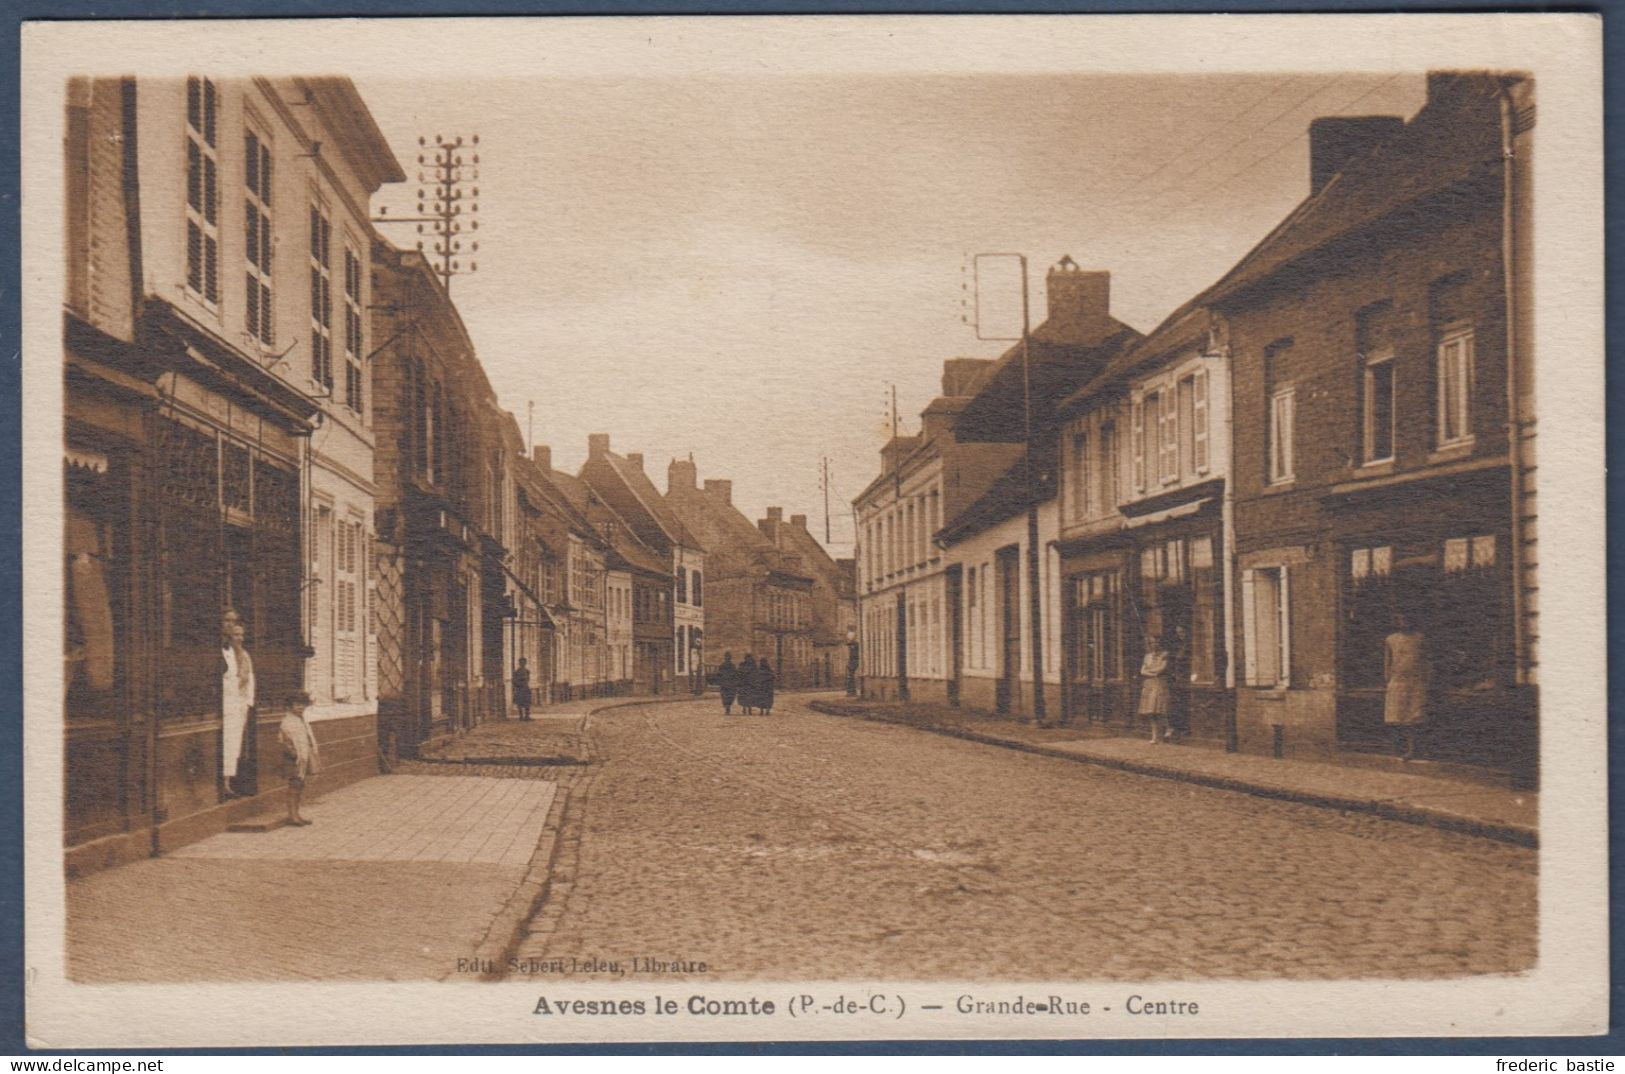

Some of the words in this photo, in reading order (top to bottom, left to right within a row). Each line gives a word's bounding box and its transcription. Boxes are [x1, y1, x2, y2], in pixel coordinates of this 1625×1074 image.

[632, 957, 707, 973] Libraire
[532, 996, 646, 1015] Avesnes
[654, 996, 678, 1014] le
[687, 996, 775, 1015] Comte
[788, 994, 906, 1018] (P.-de-C.)
[956, 995, 1091, 1015] Grande-Rue
[1126, 995, 1200, 1015] Centre
